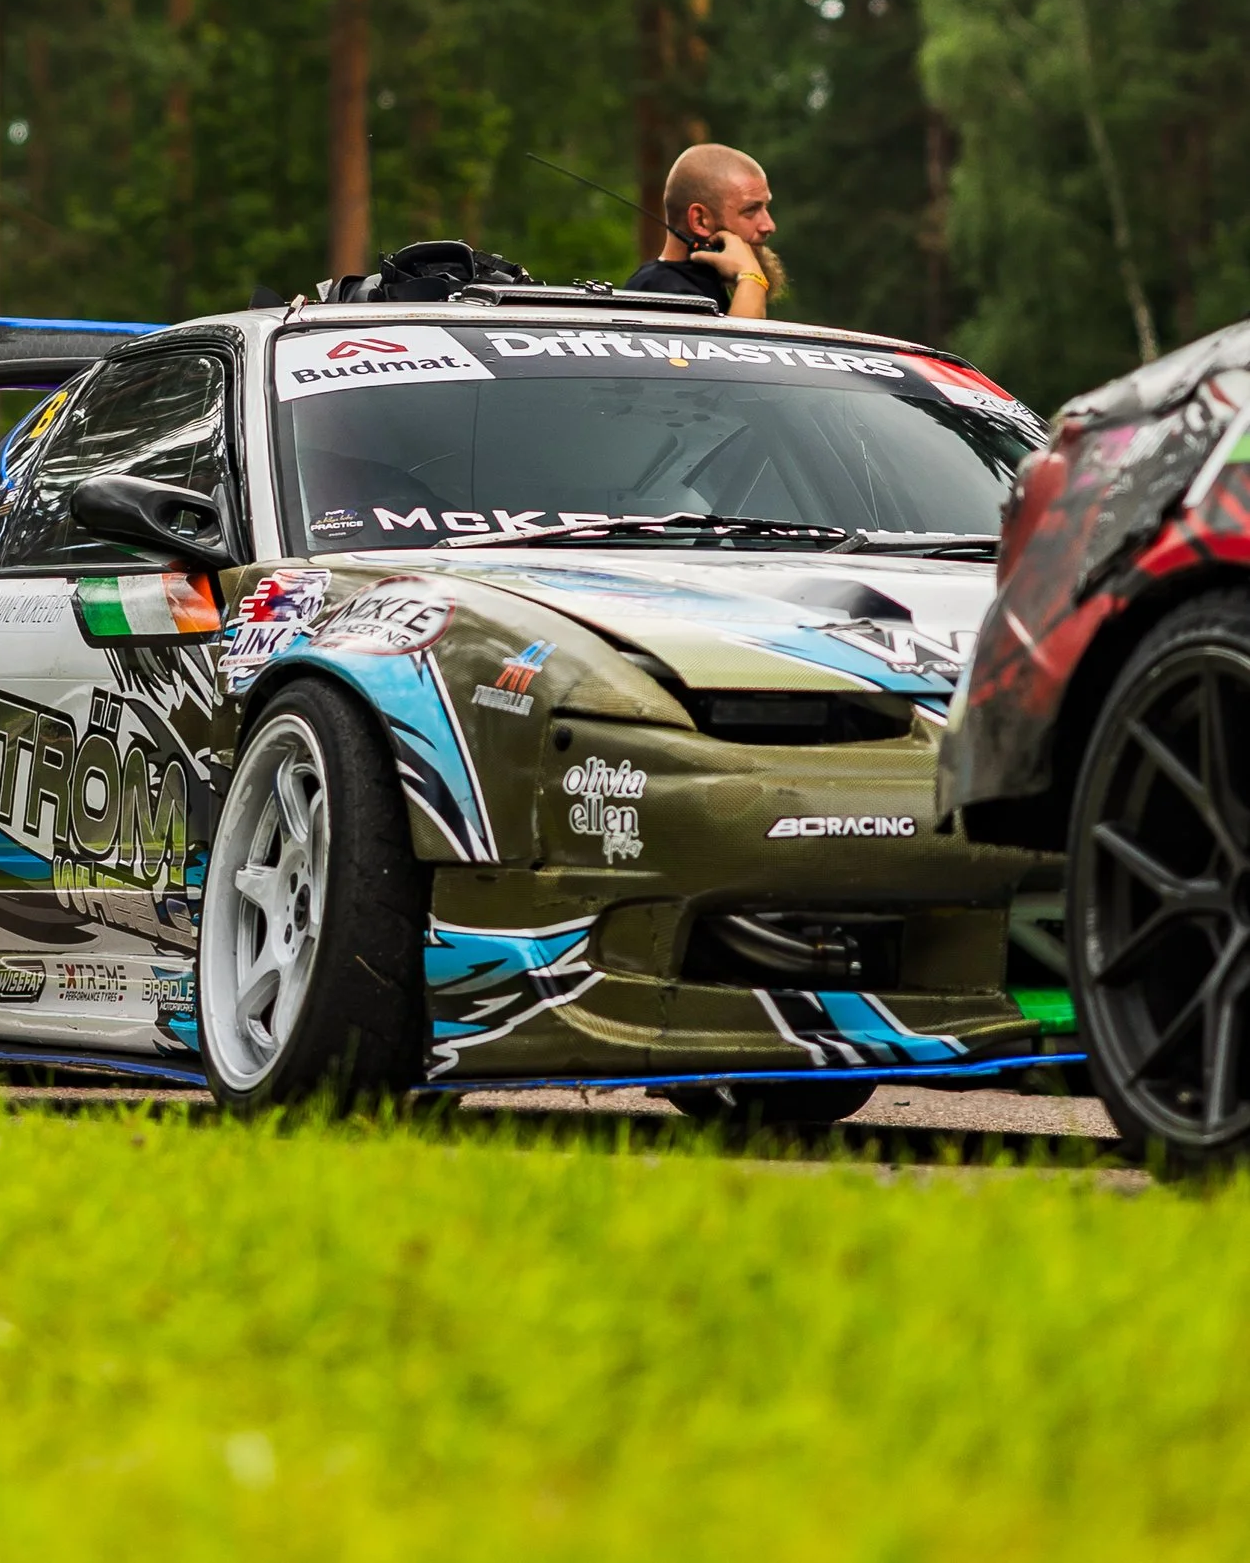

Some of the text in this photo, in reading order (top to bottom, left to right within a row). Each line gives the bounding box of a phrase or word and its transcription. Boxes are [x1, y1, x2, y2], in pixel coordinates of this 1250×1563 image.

[290, 355, 471, 384] Budmat.
[310, 520, 364, 532] PRACTICE
[565, 758, 646, 797] olivia
[571, 795, 638, 834] ellen
[53, 854, 198, 950] WHEELS
[56, 963, 128, 991] EXTREME
[64, 991, 118, 1003] PERFORMANCE TYRES
